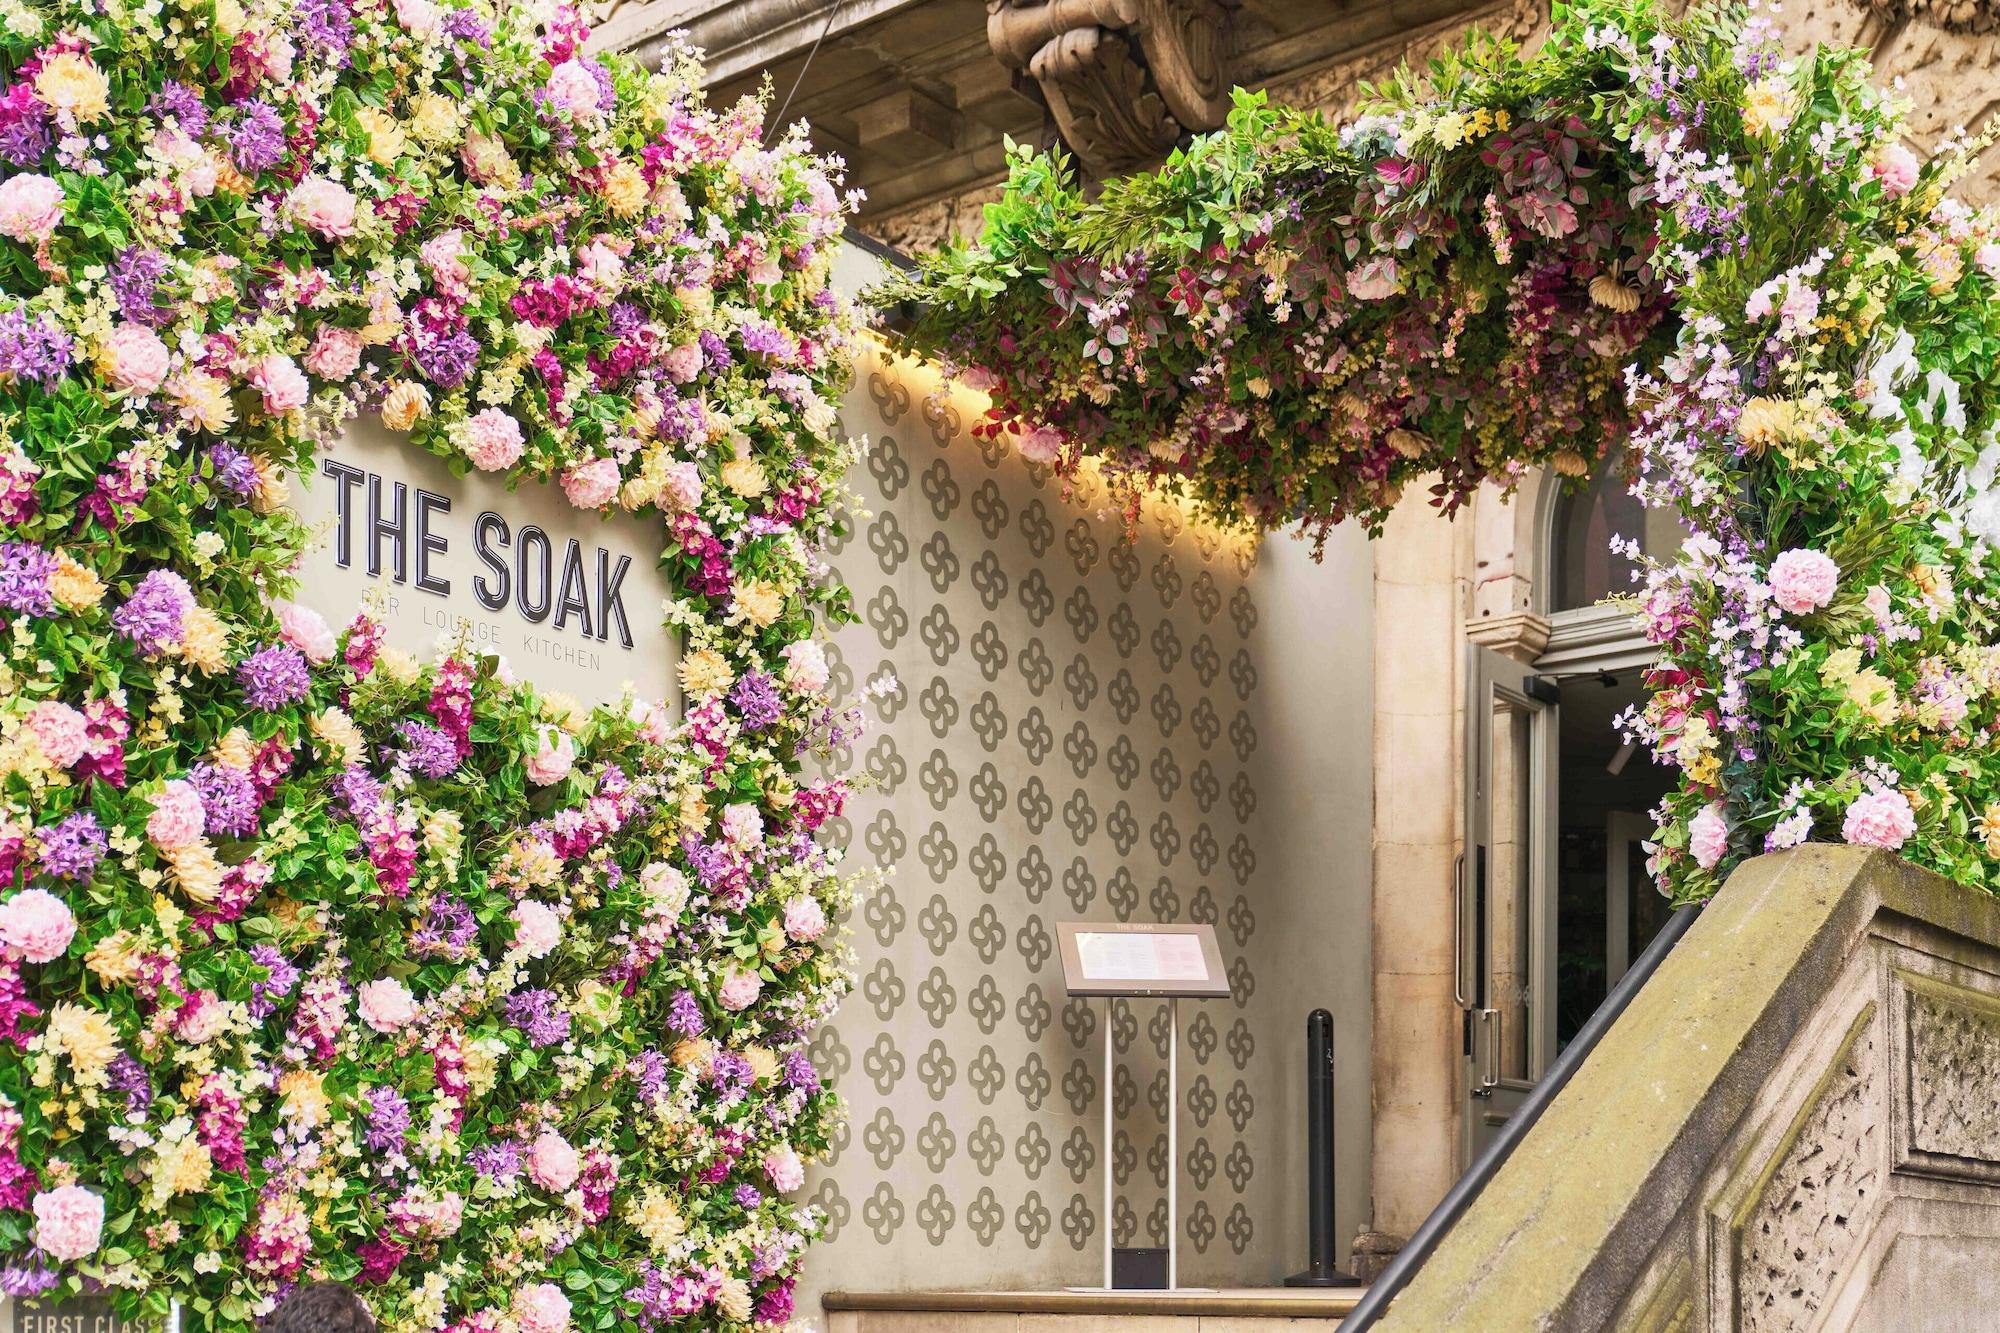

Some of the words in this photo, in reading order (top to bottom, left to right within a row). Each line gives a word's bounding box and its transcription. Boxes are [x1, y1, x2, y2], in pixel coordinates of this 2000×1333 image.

[322, 457, 452, 598] THE
[471, 511, 635, 650] SOAK
[423, 606, 501, 644] LOUNGE
[523, 634, 600, 671] KITCHEN
[23, 1316, 84, 1333] FIRST
